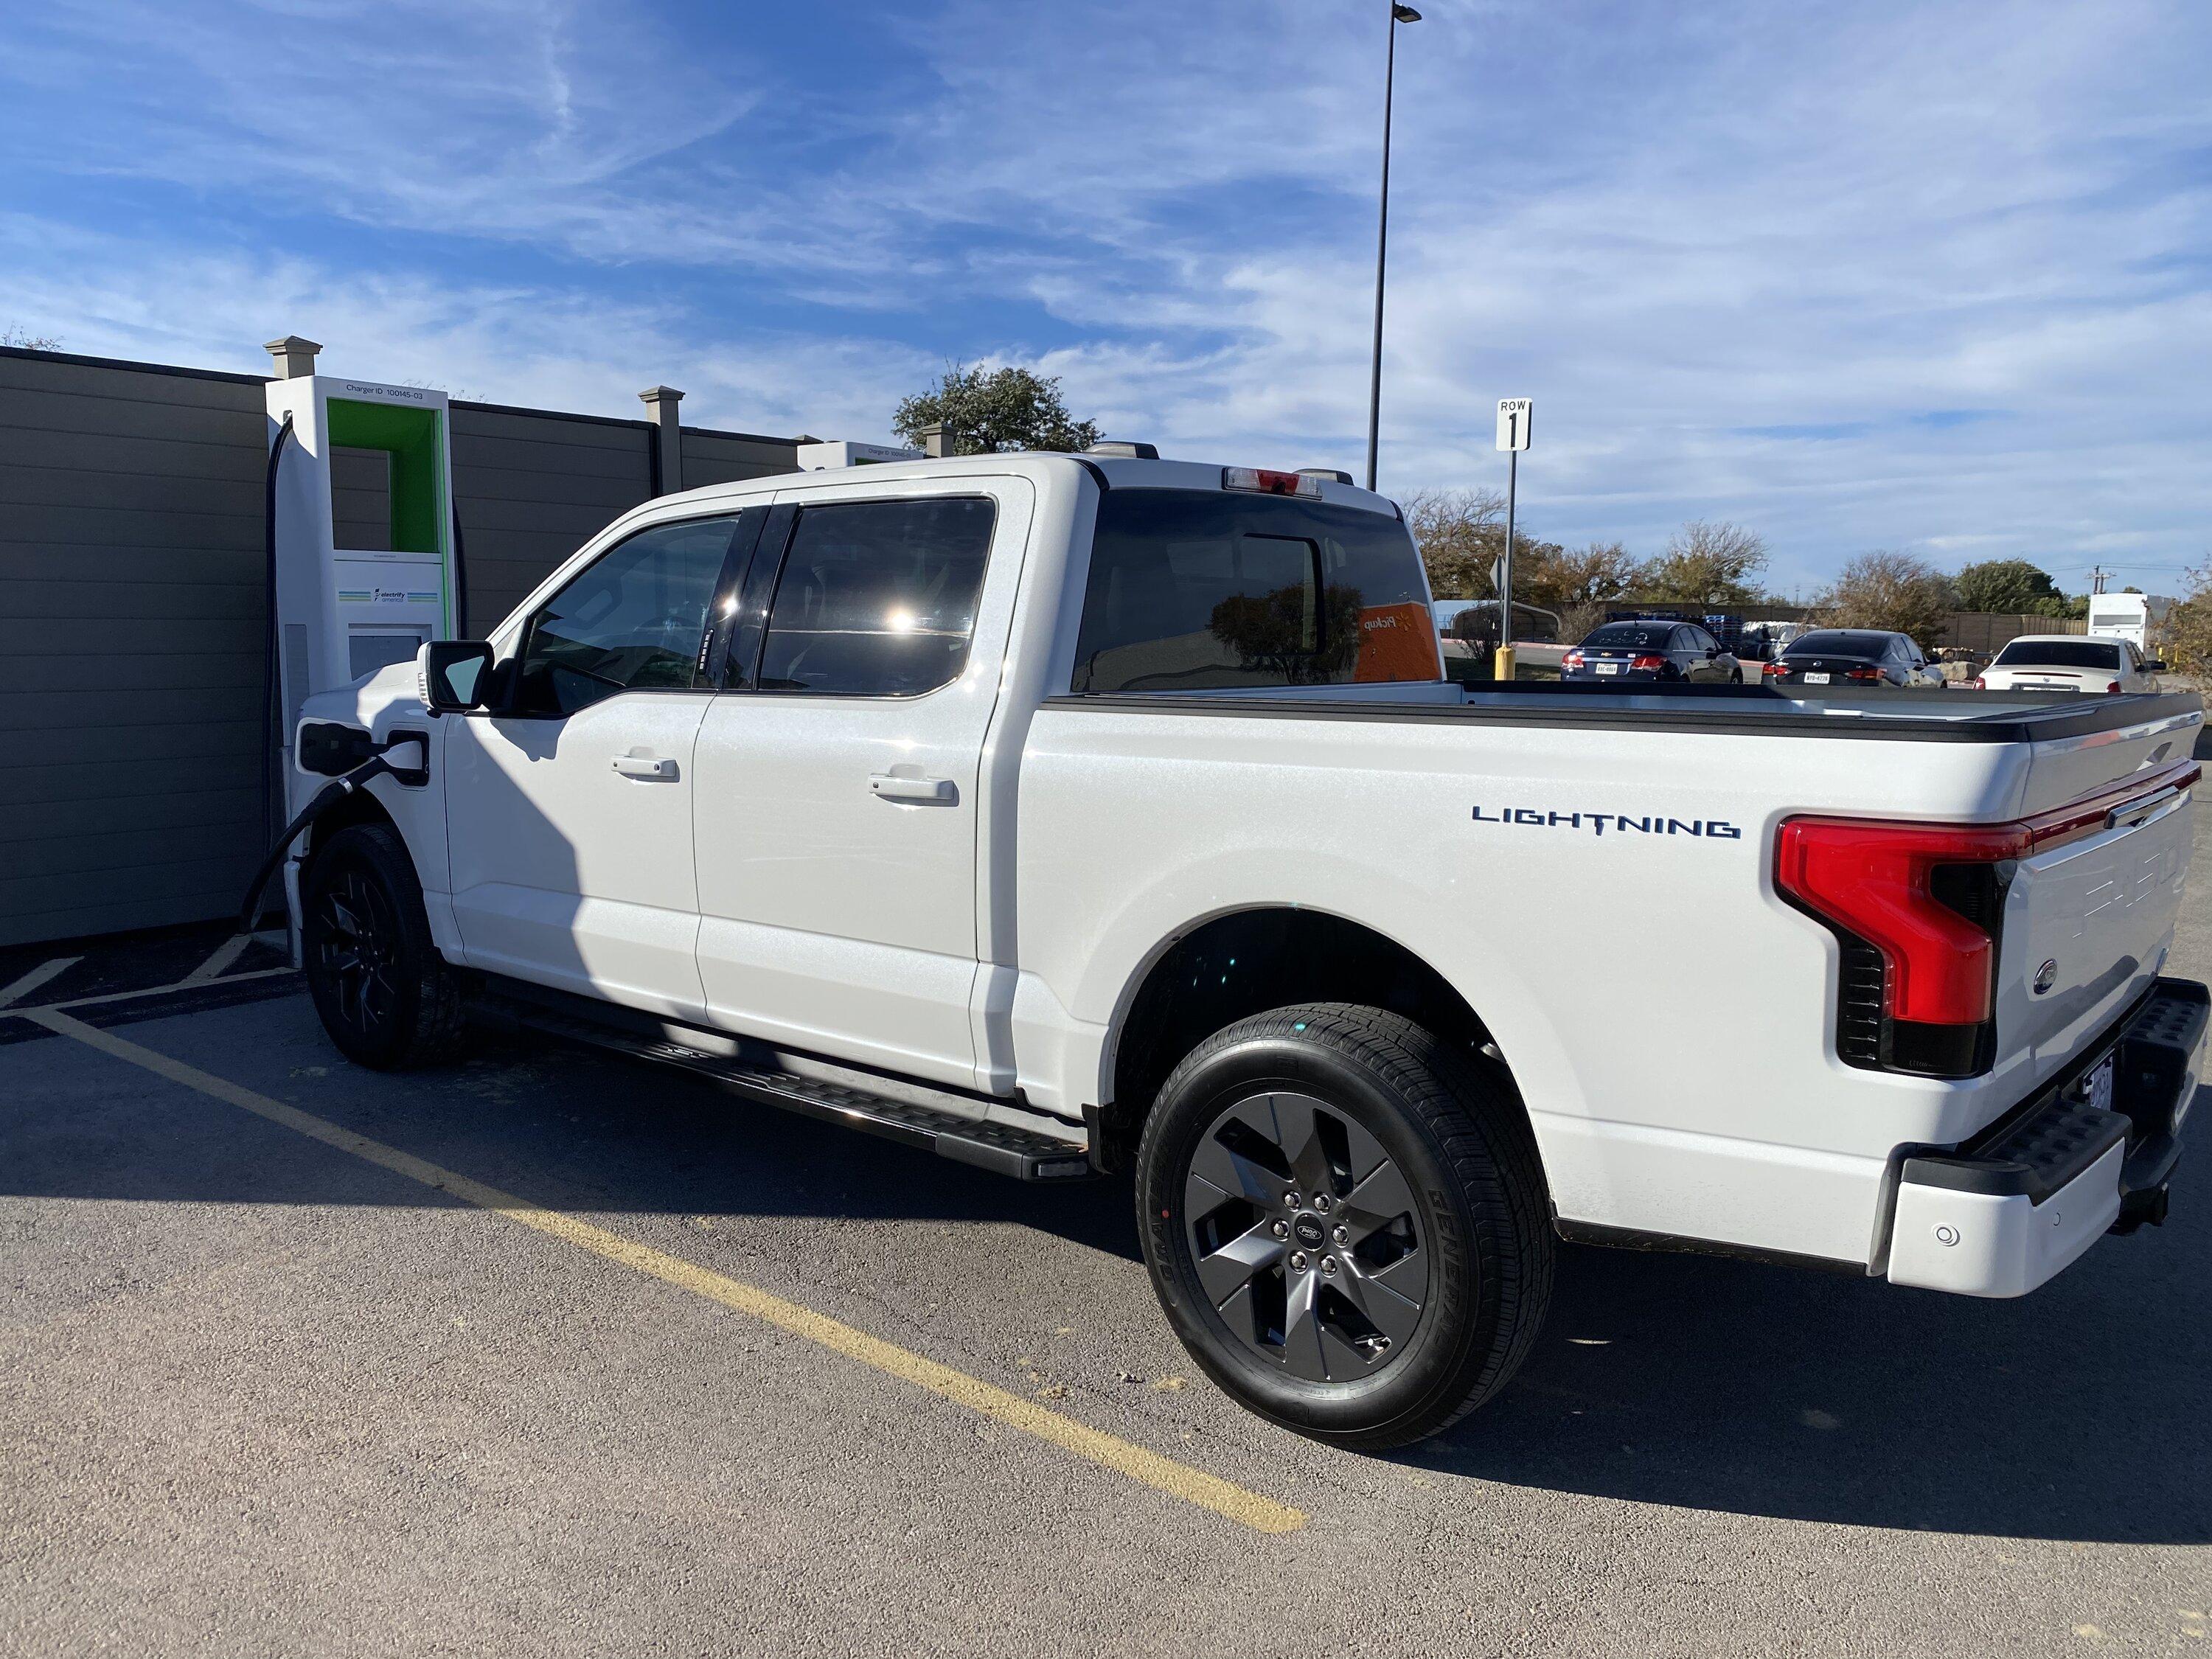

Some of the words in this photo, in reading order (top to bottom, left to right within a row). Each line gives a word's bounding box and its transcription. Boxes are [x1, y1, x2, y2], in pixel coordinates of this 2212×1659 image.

[346, 384, 374, 394] Charger
[386, 389, 423, 400] 100145-03
[1500, 400, 1526, 411] ROW
[1509, 412, 1517, 448] 1
[1472, 806, 1742, 839] LIGHTNING
[1427, 1188, 1461, 1345] GENERAL
